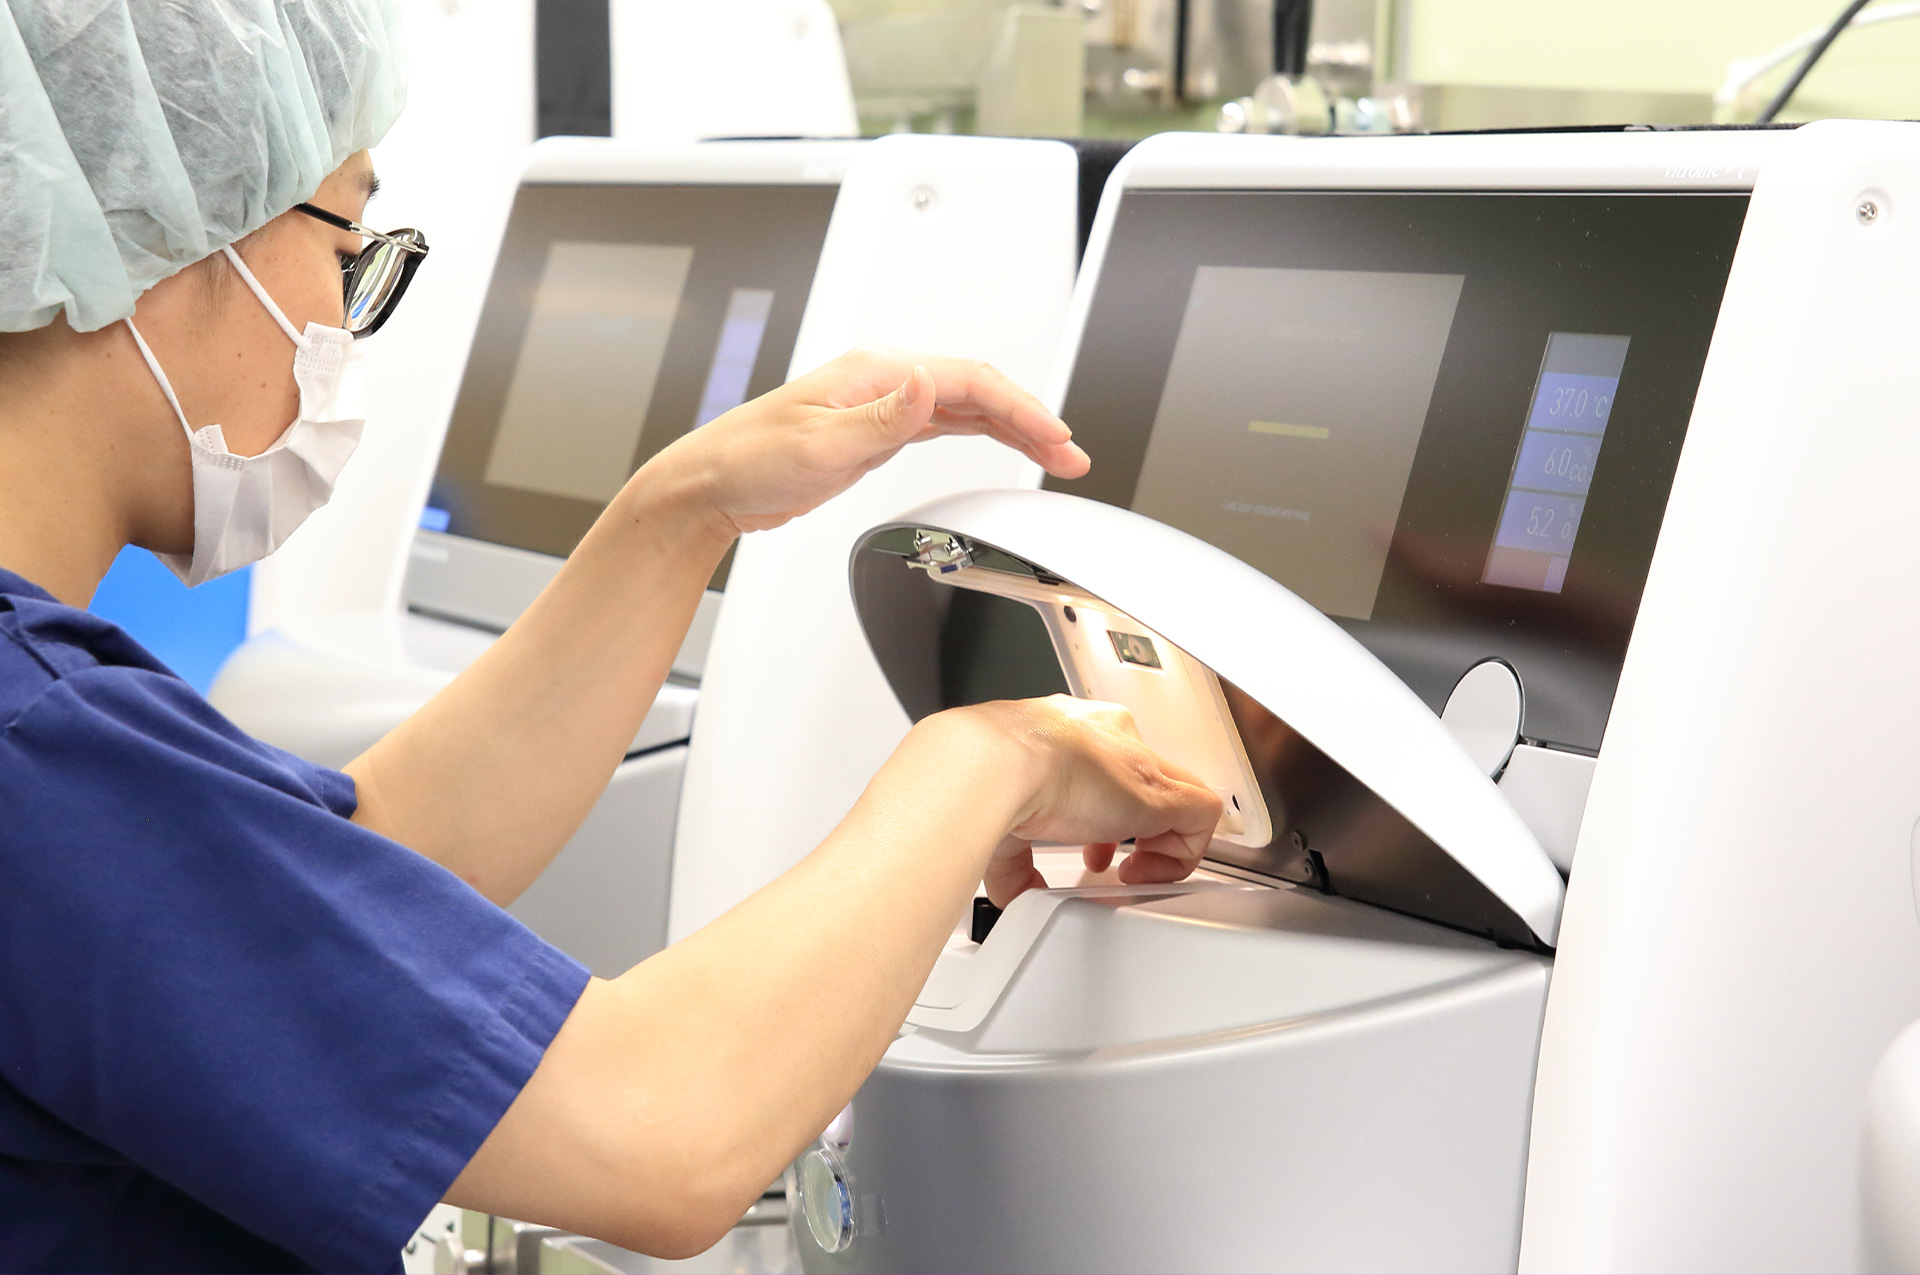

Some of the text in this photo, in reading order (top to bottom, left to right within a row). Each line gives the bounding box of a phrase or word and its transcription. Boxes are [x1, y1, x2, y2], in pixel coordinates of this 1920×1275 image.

[1549, 386, 1588, 417] 37.0
[1544, 447, 1572, 476] 6.0
[1526, 506, 1555, 538] 5.2
